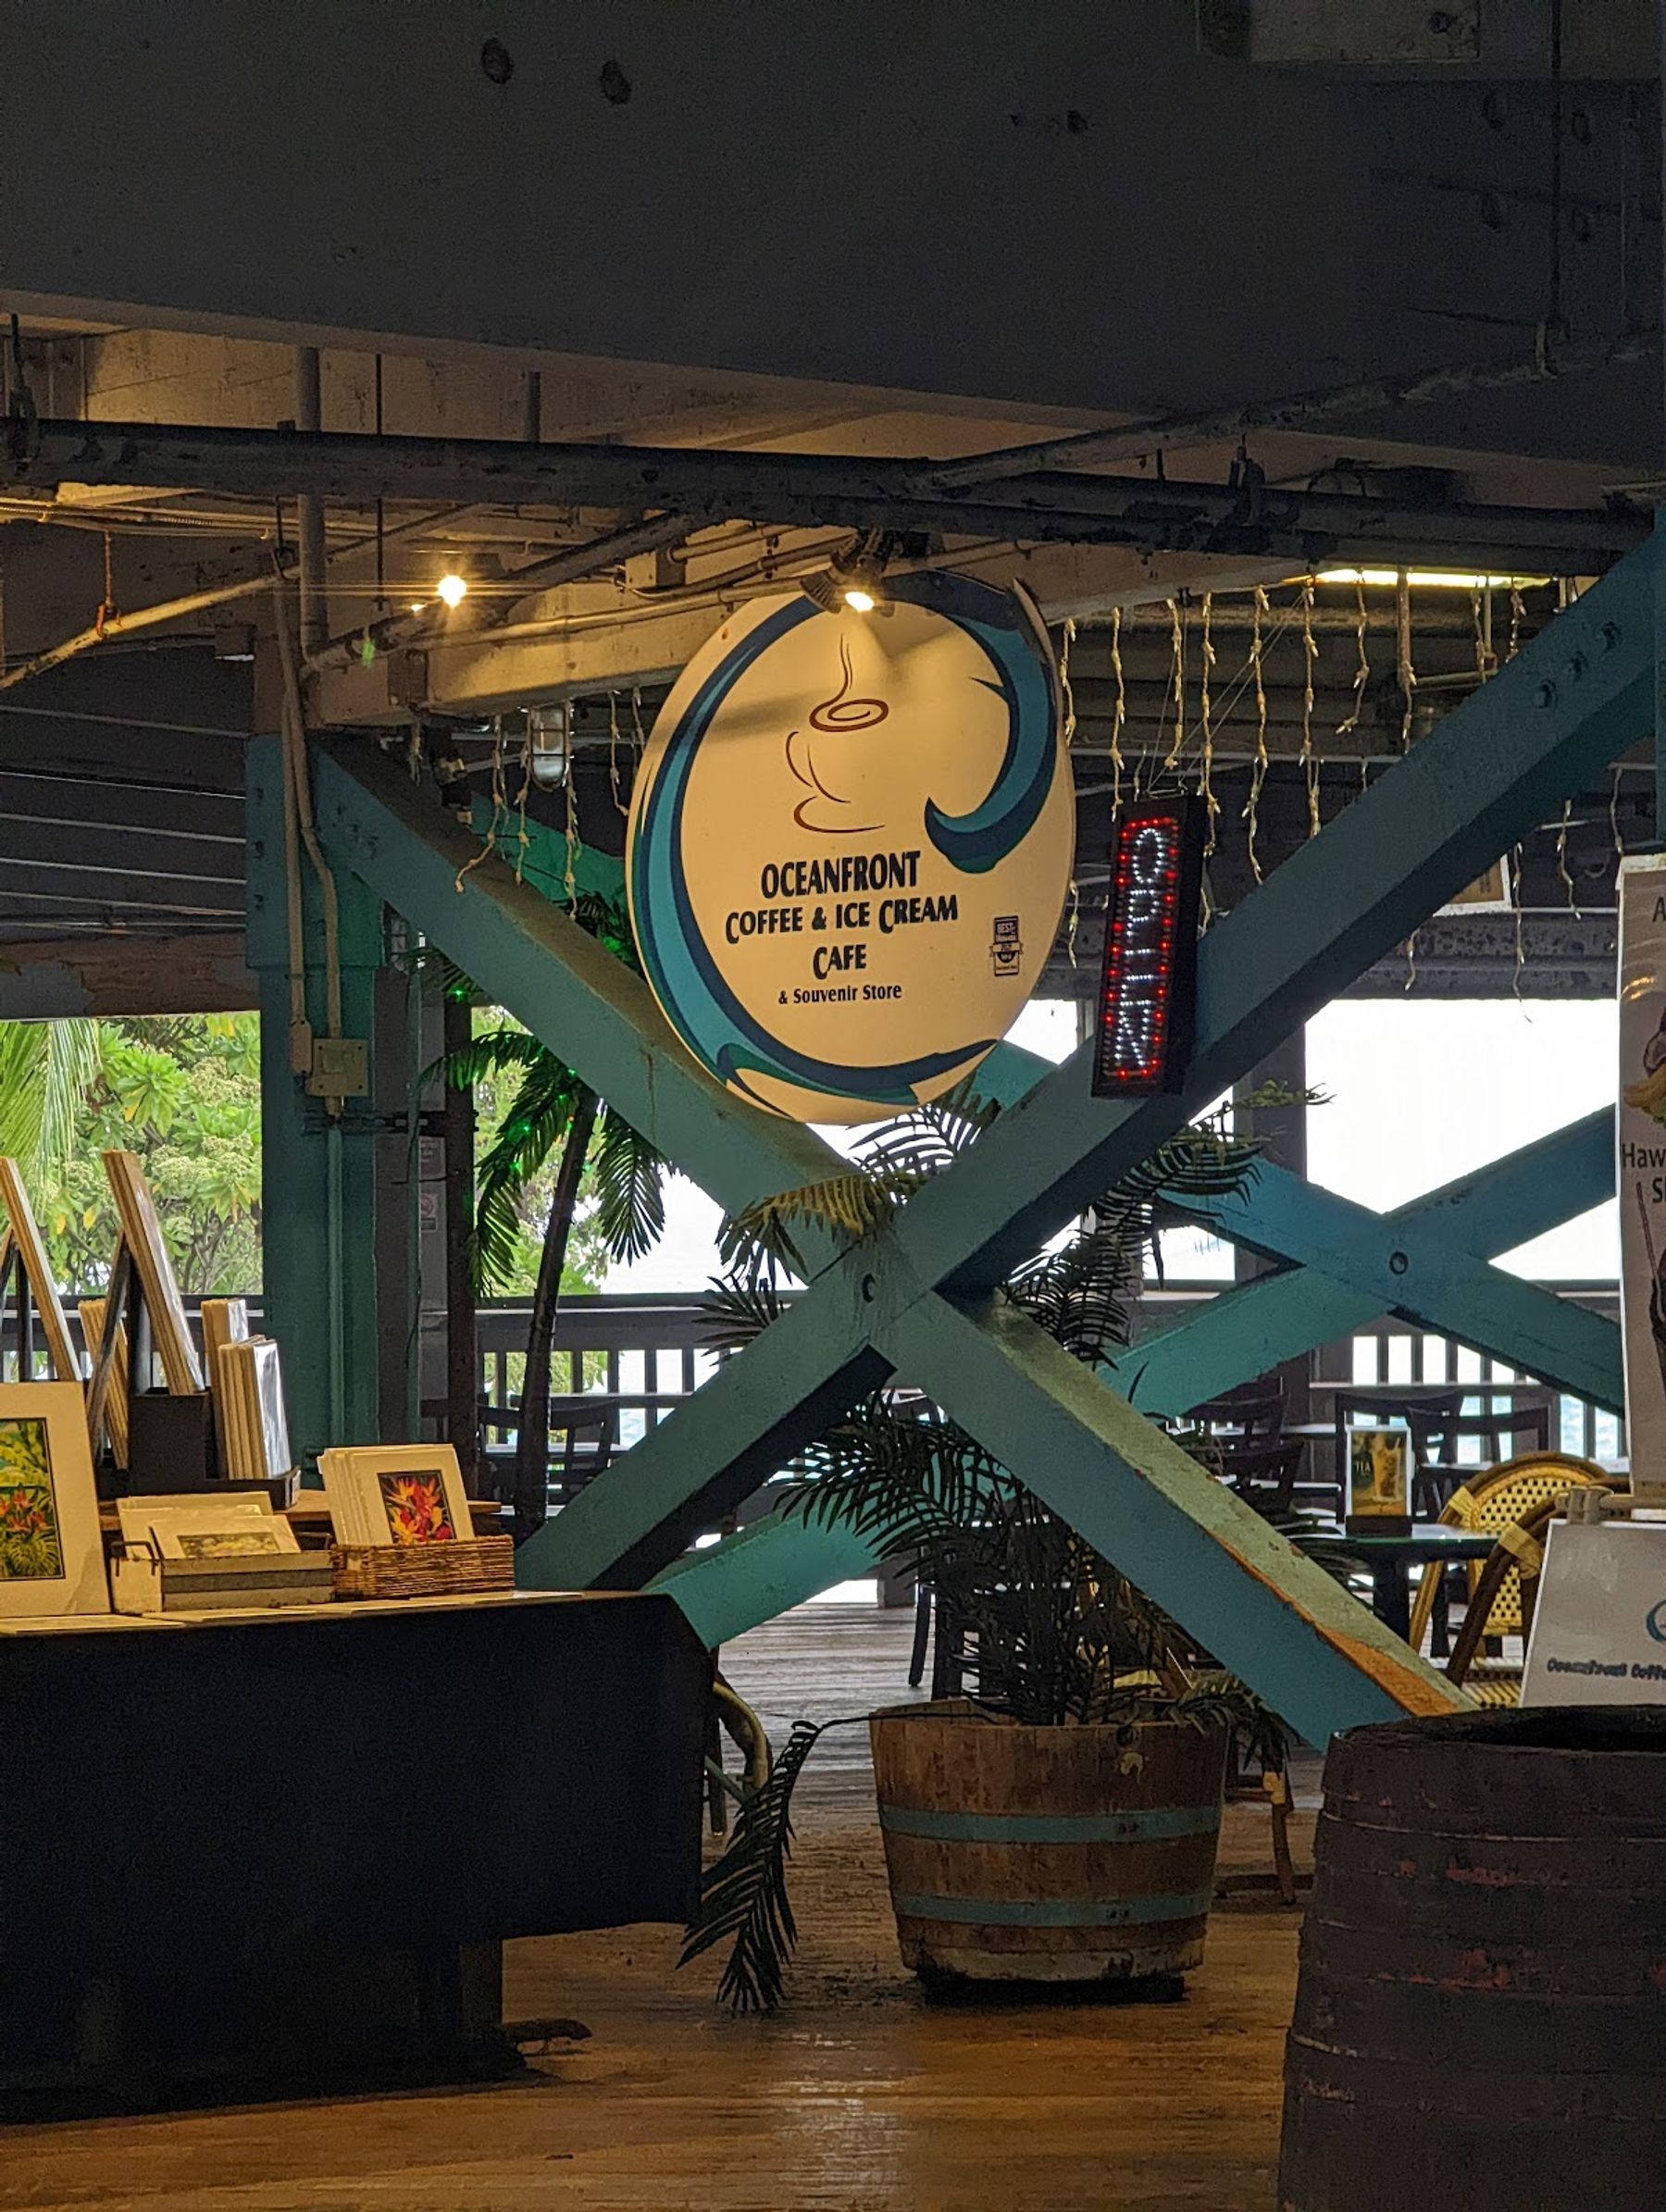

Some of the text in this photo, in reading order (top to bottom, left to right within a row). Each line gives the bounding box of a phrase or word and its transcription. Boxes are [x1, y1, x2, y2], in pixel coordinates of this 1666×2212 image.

[761, 851, 921, 899] OCEANFRONT
[726, 895, 958, 944] COFFEE & ICE CREAM
[813, 944, 866, 980] CAFE
[1113, 826, 1164, 1067] OPEN
[778, 984, 901, 1004] & Souvenir Store
